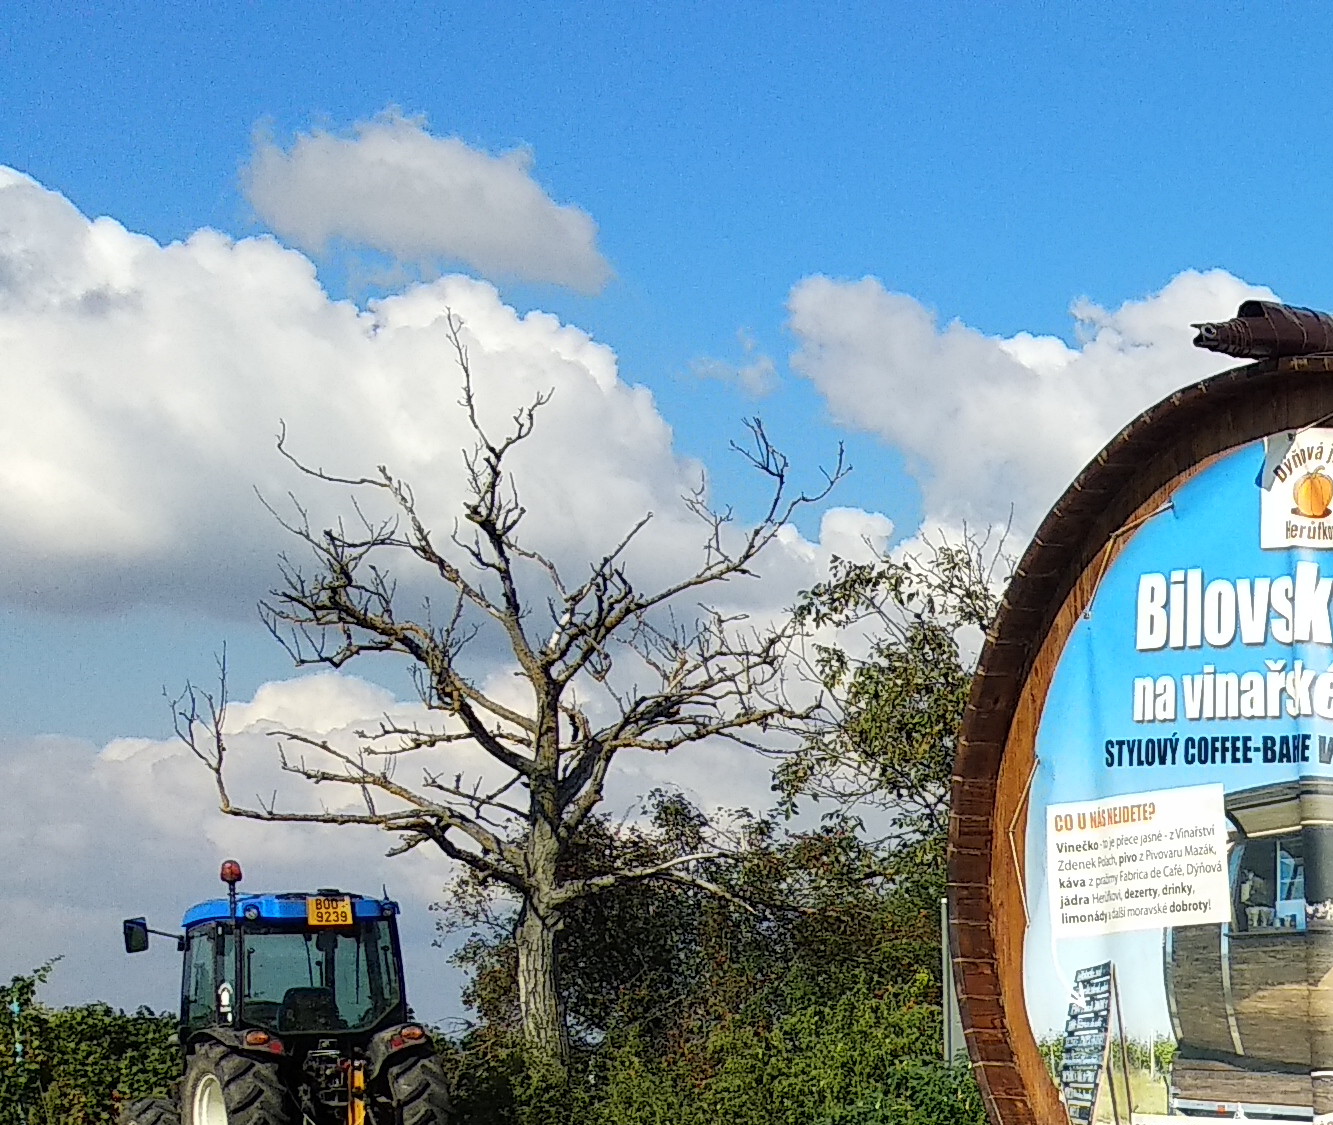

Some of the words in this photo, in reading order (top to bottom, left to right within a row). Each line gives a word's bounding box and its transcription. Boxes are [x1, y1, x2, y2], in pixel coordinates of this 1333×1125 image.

[1273, 441, 1324, 483] Dýňová
[1132, 673, 1176, 722] na
[1105, 732, 1179, 767] STYLOVÝ
[1054, 813, 1073, 832] CO
[1077, 812, 1087, 831] U
[1090, 806, 1106, 829] NÁS
[1056, 840, 1099, 854] Vinečko
[1116, 833, 1138, 849] přece
[1140, 829, 1163, 847] jasné
[1169, 831, 1174, 840] z
[1175, 824, 1215, 840] Vinařství
[1057, 857, 1096, 872] Zdenek
[1118, 851, 1138, 866] pivo
[1139, 851, 1144, 862] z
[1145, 848, 1183, 861] Pivovaru
[1184, 843, 1217, 857] Mazák,
[1059, 875, 1086, 889] káva
[1088, 876, 1094, 887] z
[1119, 869, 1149, 882] Fabrica
[1150, 866, 1162, 878] de
[1163, 865, 1185, 878] Café,
[1186, 860, 1222, 879] Dýňová
[1059, 894, 1090, 910] jádra
[1124, 886, 1160, 901] dezerty,
[1161, 881, 1195, 896] drinky,
[316, 911, 348, 923] 9239
[1061, 910, 1108, 925] limonády
[1127, 902, 1168, 918] moravské
[1169, 899, 1212, 914] dobroty!
